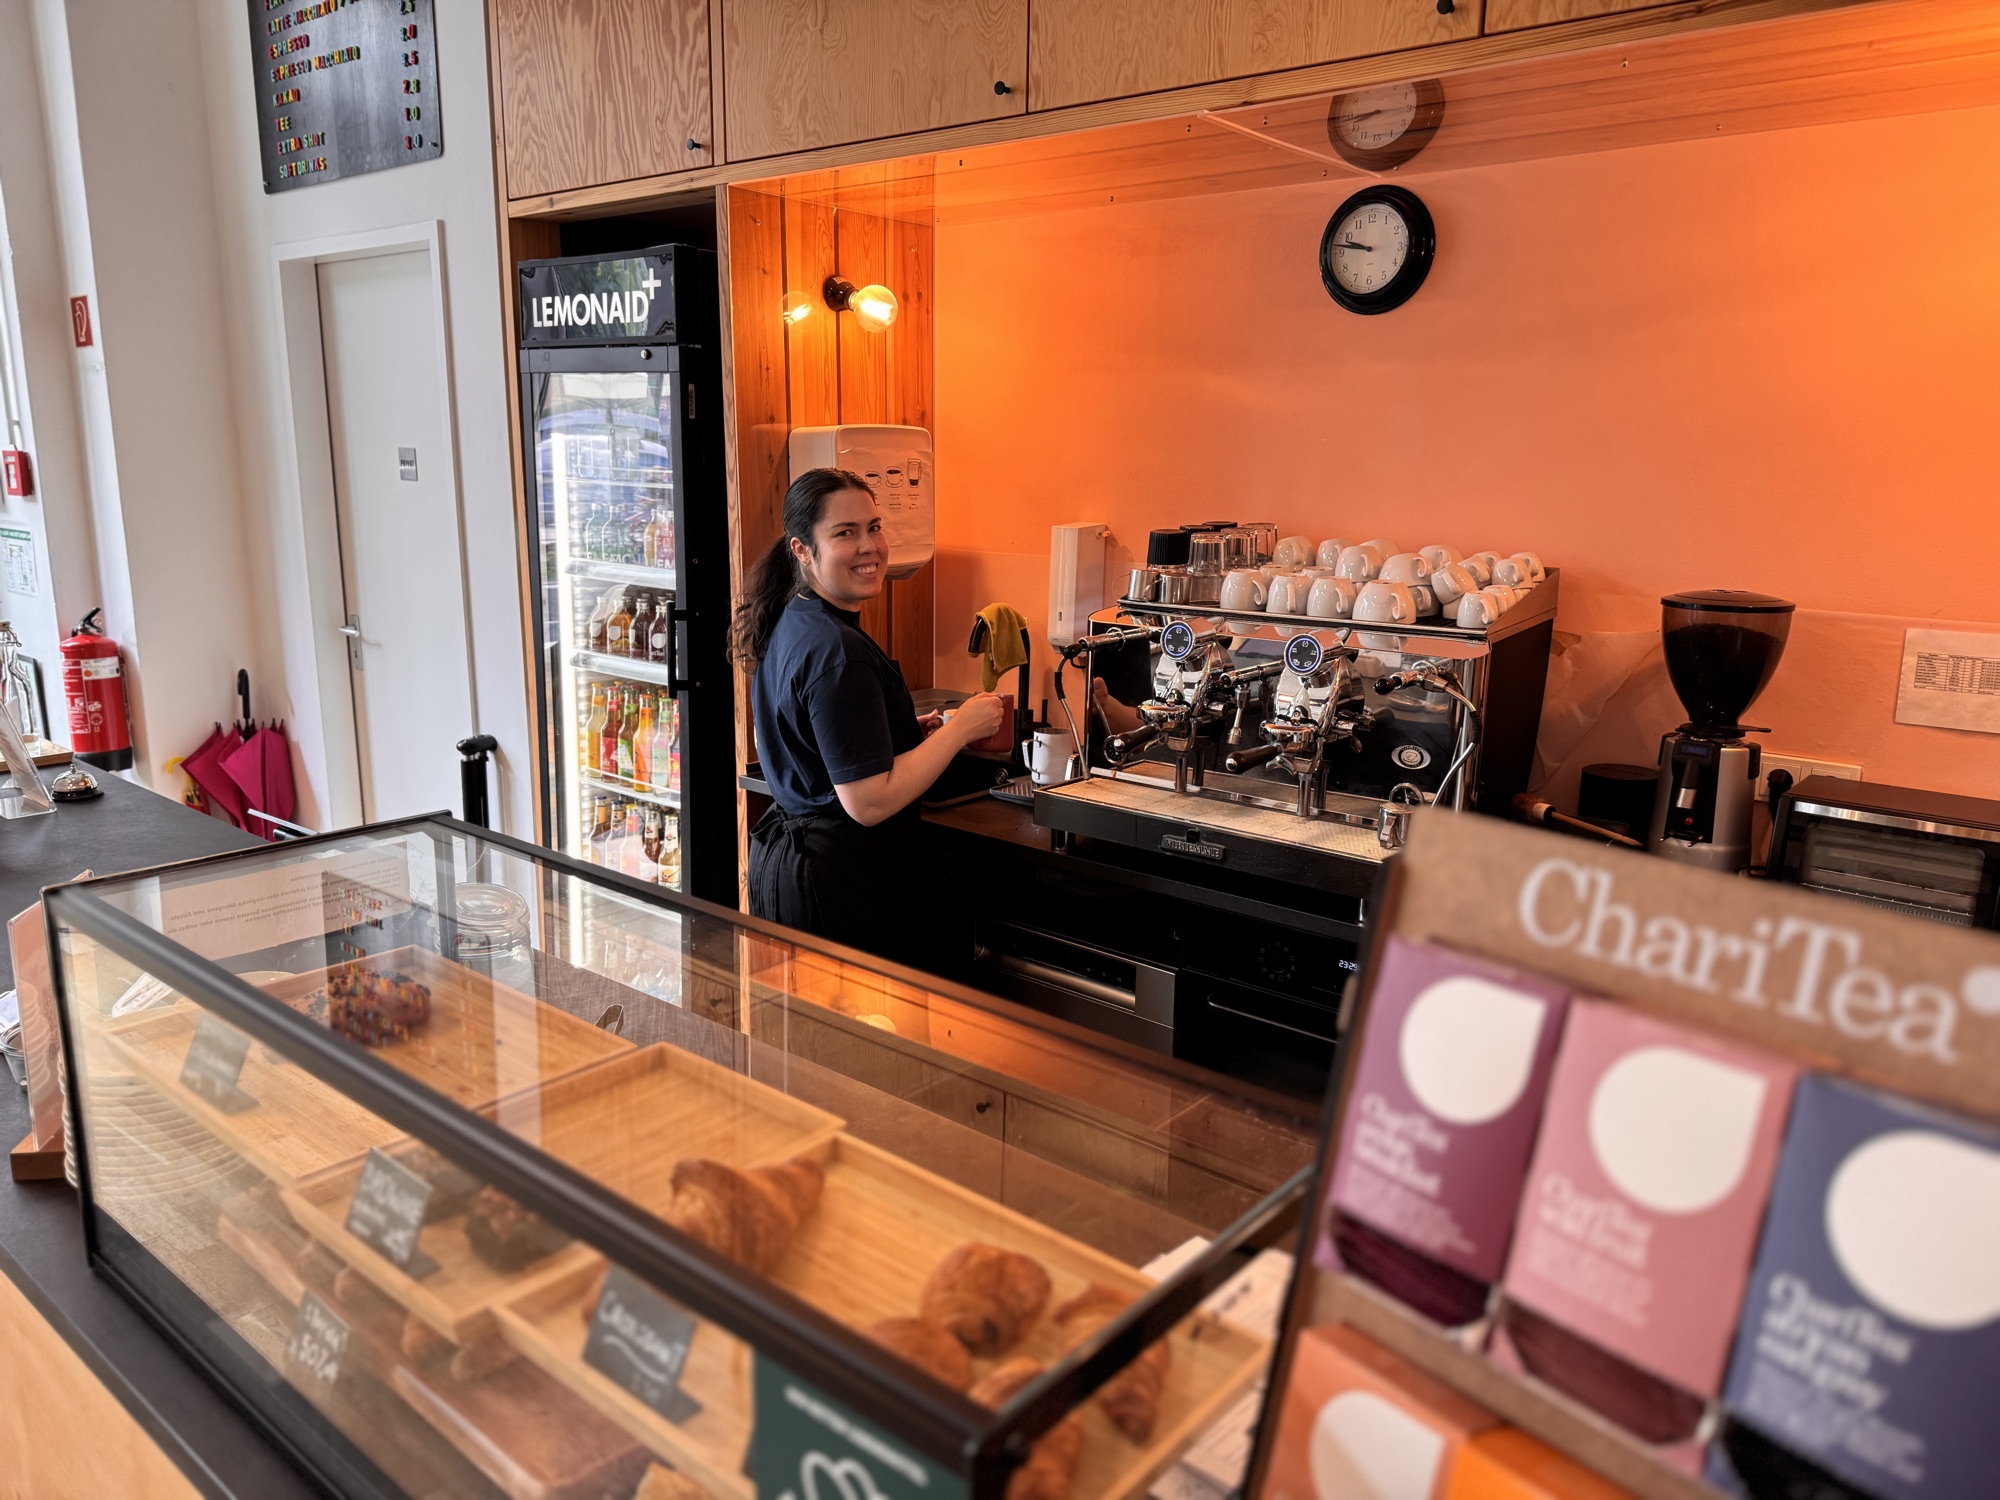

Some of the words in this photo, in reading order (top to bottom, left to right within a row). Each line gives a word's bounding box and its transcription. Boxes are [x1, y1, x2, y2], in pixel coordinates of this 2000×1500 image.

[267, 14, 291, 35] LATTE
[291, 0, 338, 25] MACCHIATO
[268, 34, 310, 60] ESPRESSO
[270, 59, 312, 83] ESPRESSO
[313, 46, 361, 70] MACCHIATO
[272, 88, 301, 107] KAKAO
[275, 116, 292, 132] TEE
[277, 136, 303, 155] EXTRA
[303, 131, 326, 148] SHOT
[1368, 213, 1377, 224] 12
[1384, 215, 1388, 225] 1
[1355, 219, 1362, 230] 11
[1393, 225, 1400, 235] 2
[1345, 231, 1353, 242] 10
[1397, 241, 1403, 251] 3
[1338, 248, 1345, 258] 9
[1391, 257, 1398, 267] 4
[1342, 263, 1349, 273] 8
[1353, 273, 1359, 283] 7
[1366, 275, 1373, 286] 6
[1381, 270, 1387, 280] 5
[1517, 857, 1960, 1066] ChariTea
